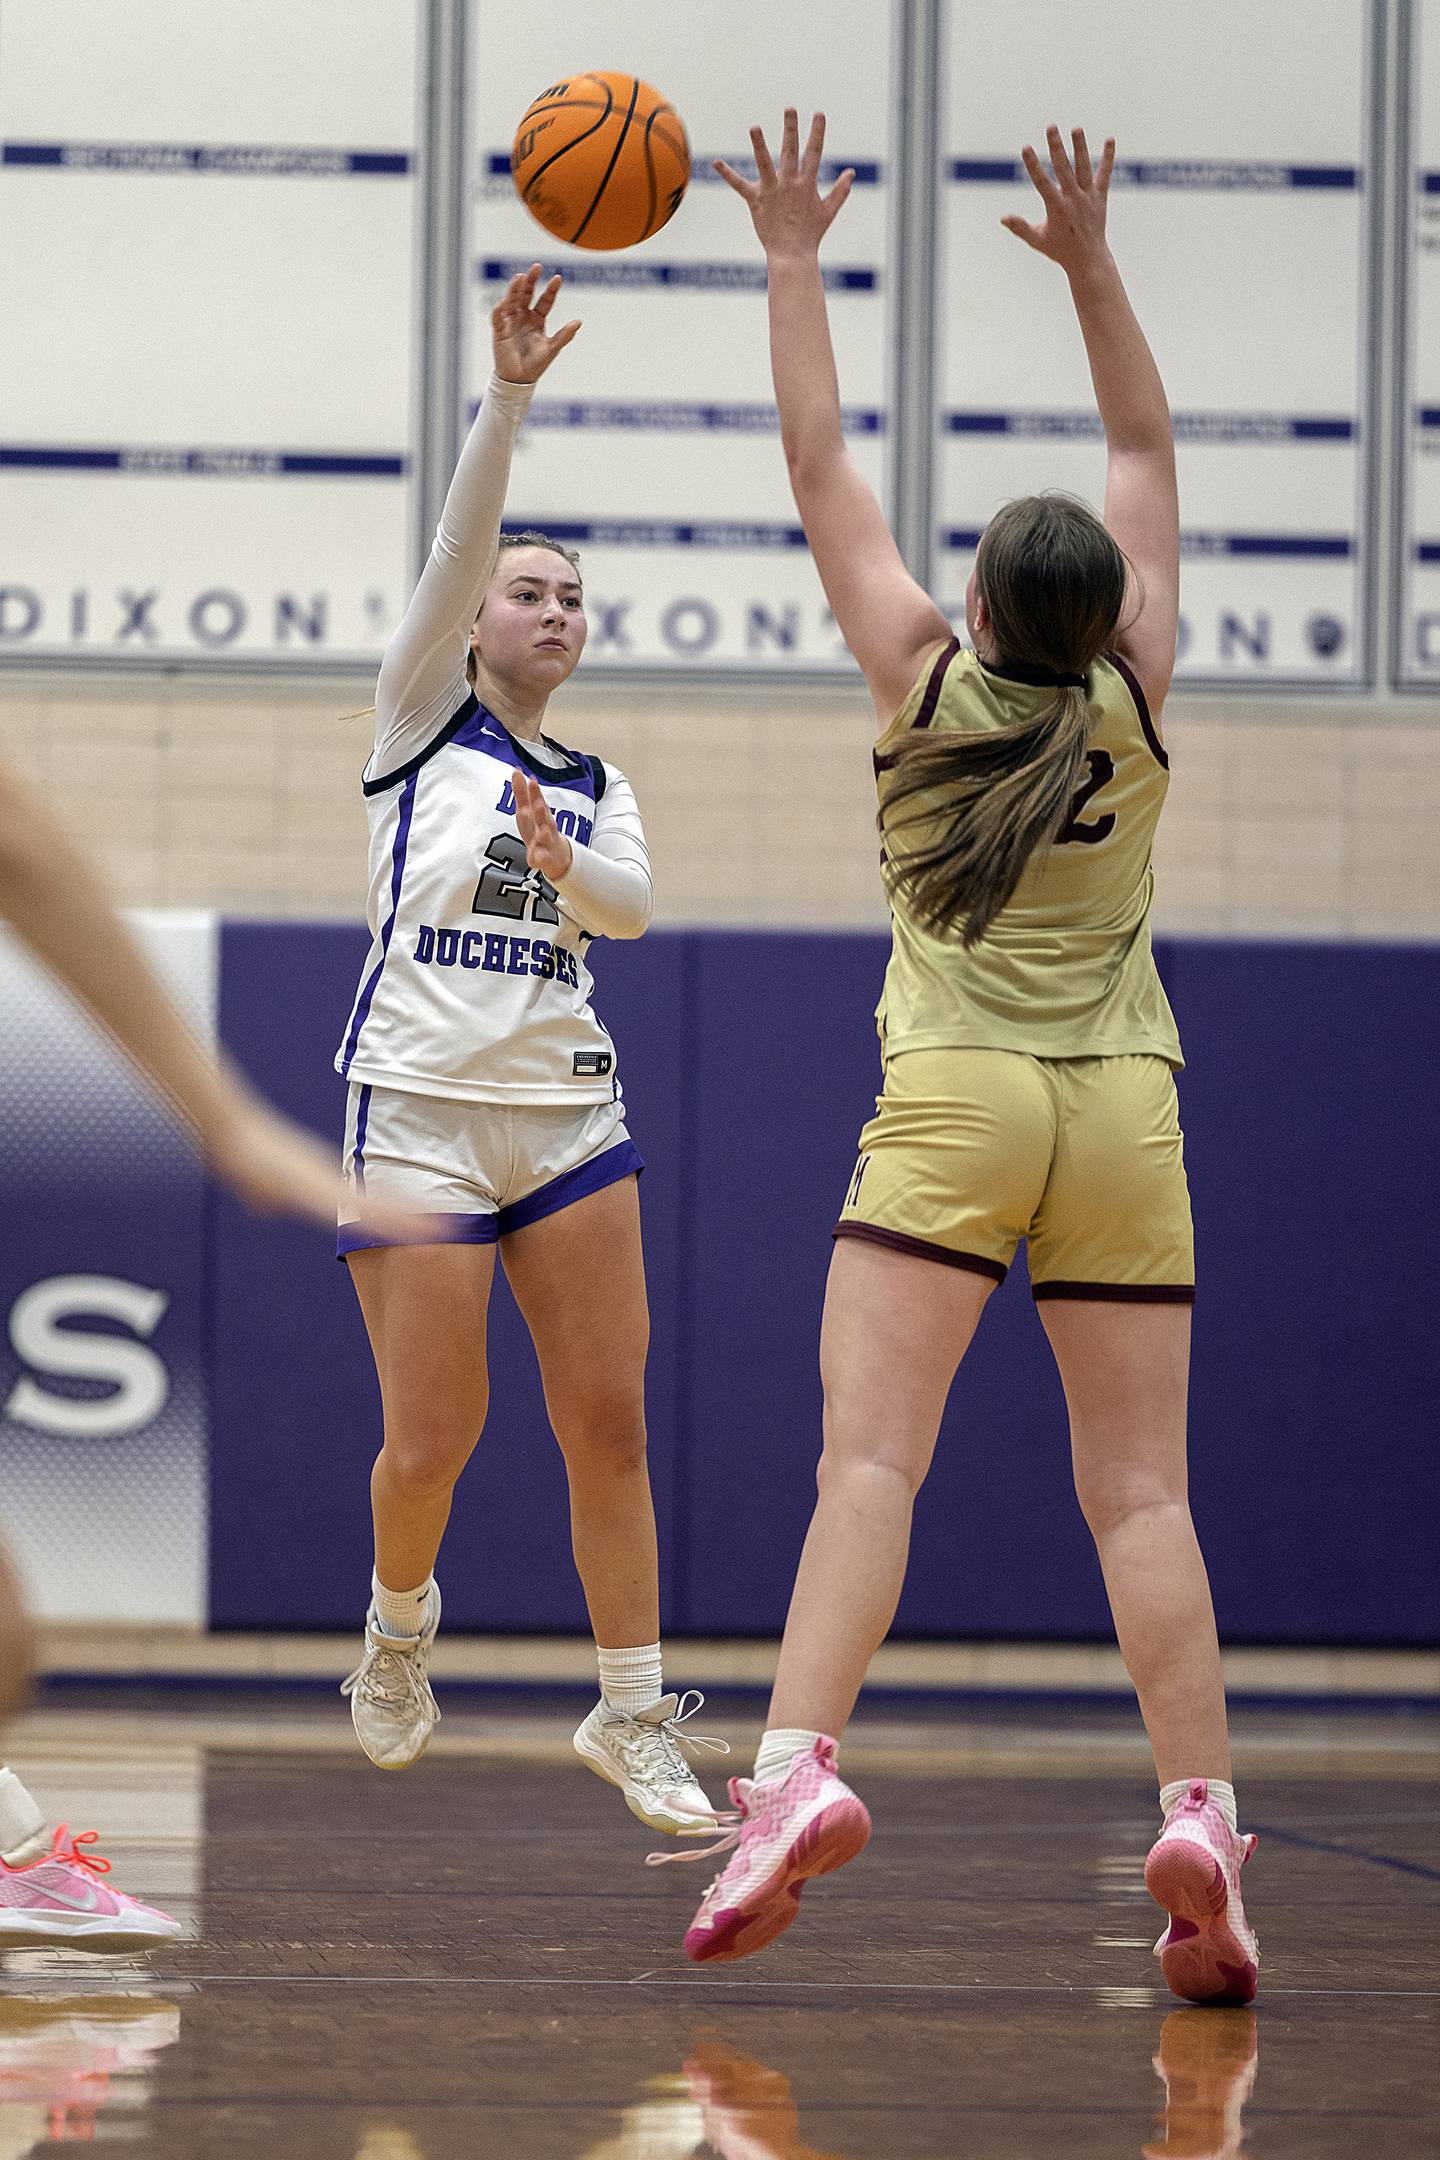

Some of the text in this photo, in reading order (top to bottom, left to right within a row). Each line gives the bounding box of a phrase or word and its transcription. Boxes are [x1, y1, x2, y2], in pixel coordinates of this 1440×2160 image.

[0, 584, 329, 648] DIXON
[592, 598, 800, 656] XON
[495, 779, 594, 849] DON
[413, 924, 579, 990] DUCHESSES
